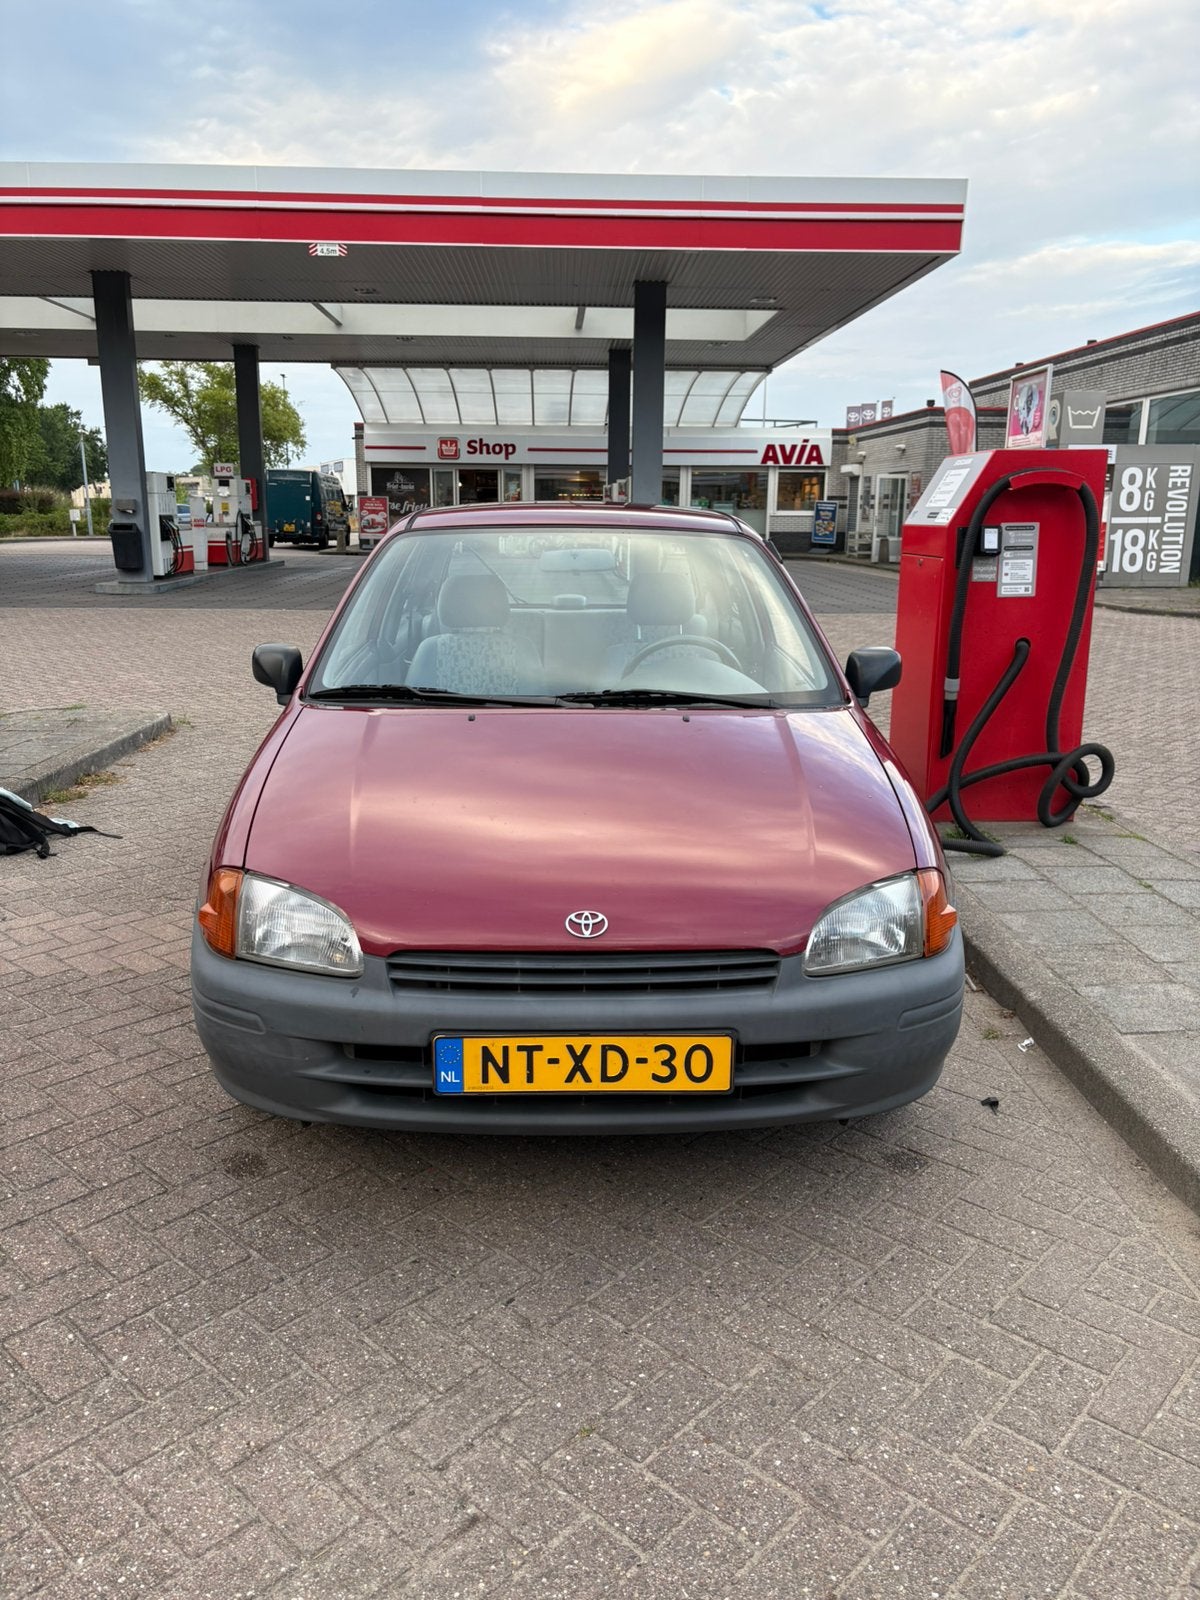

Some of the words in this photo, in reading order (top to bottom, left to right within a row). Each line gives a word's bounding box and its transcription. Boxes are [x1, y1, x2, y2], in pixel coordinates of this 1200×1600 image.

[466, 437, 516, 460] Shop
[1119, 466, 1143, 512] 8
[1158, 465, 1192, 574] REVOLUTION
[1110, 528, 1146, 573] 18
[440, 1071, 460, 1083] NL
[480, 1043, 714, 1084] NT-XD-30
